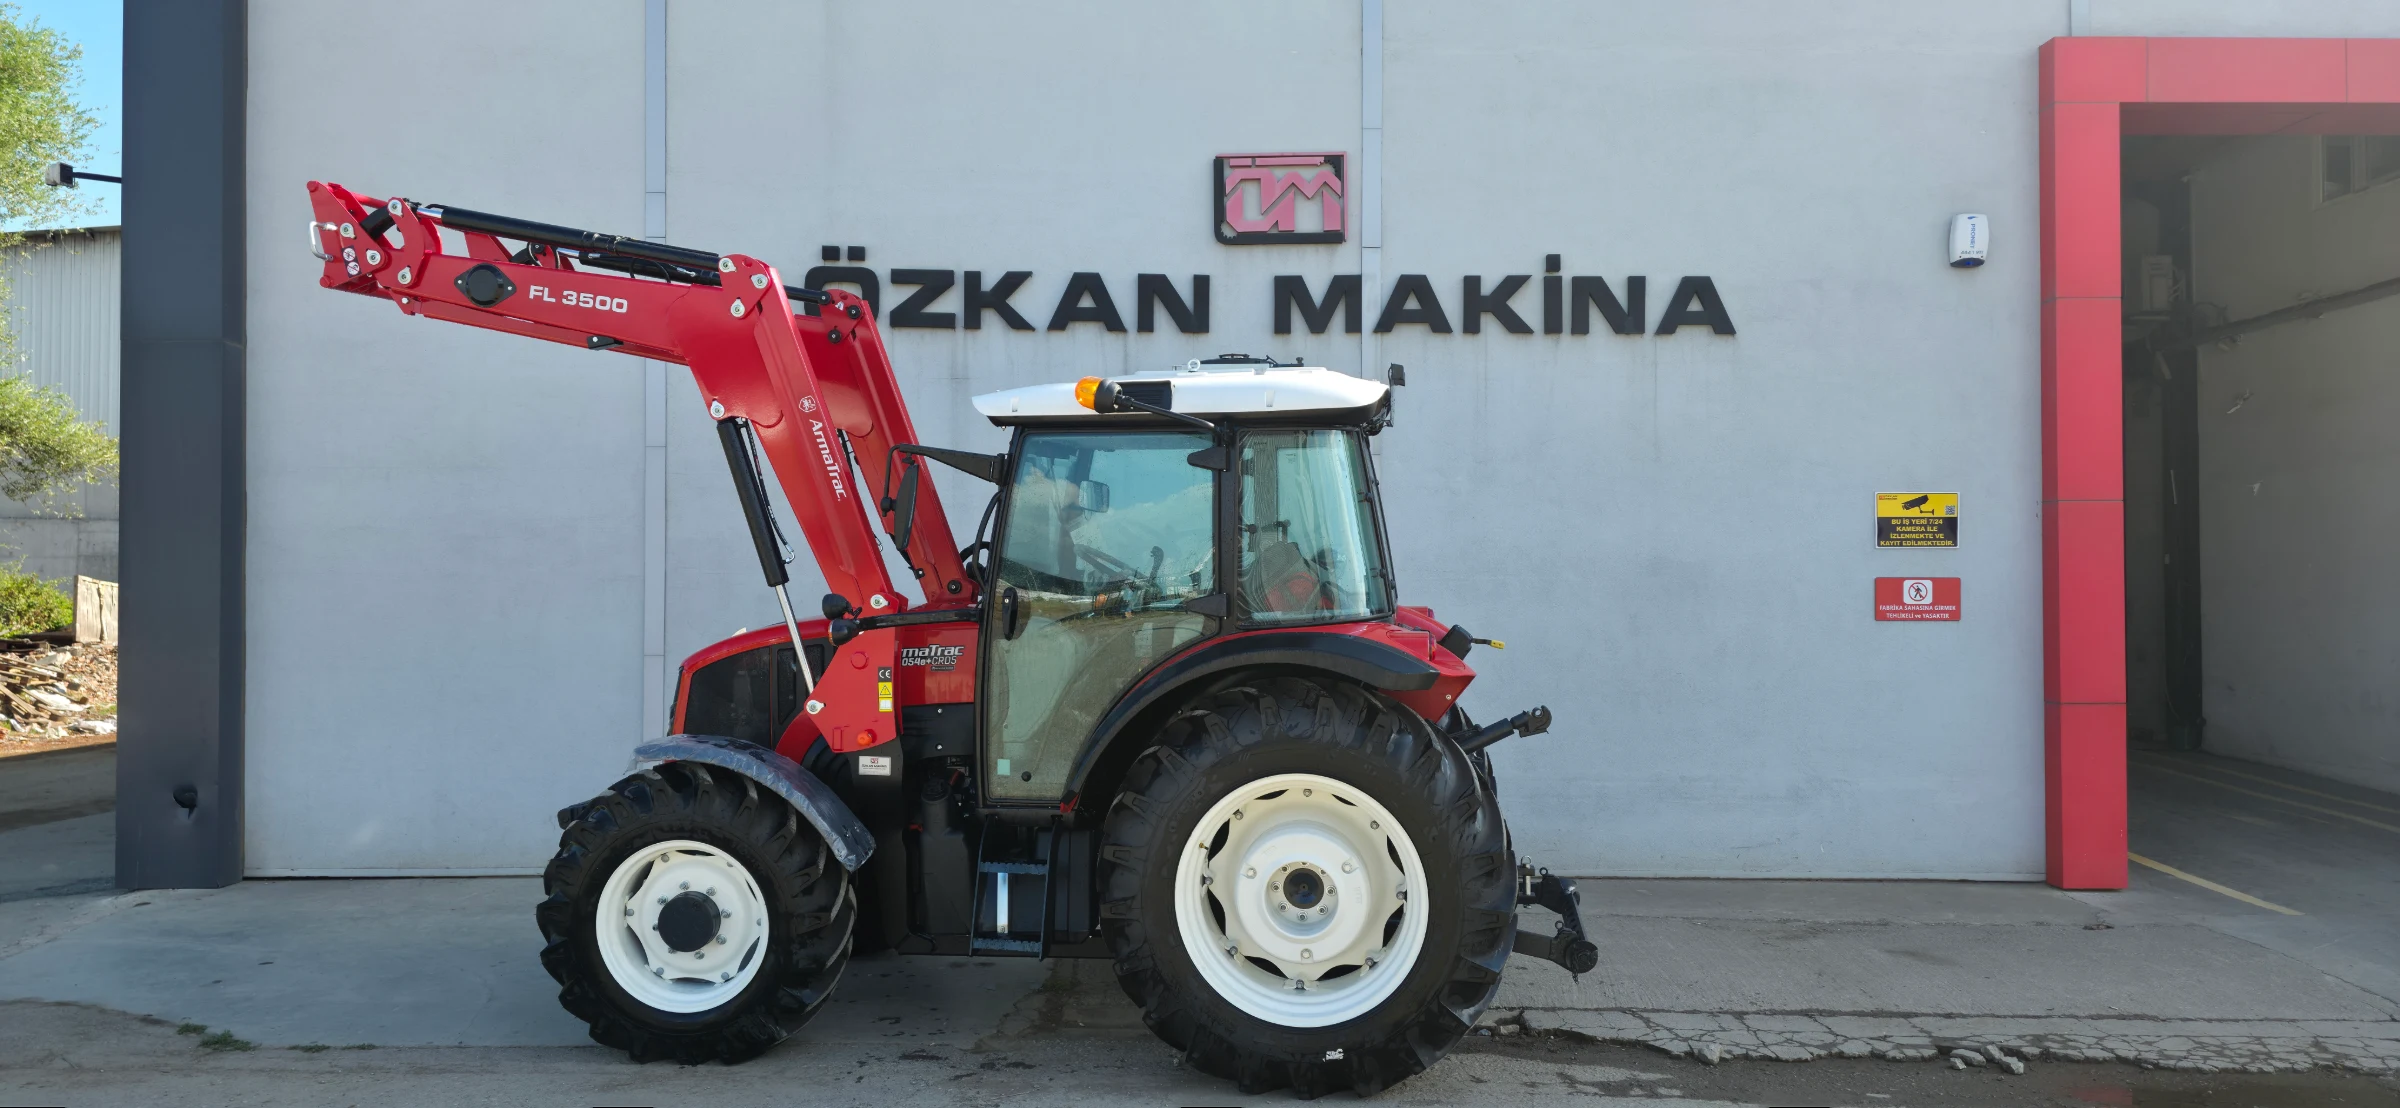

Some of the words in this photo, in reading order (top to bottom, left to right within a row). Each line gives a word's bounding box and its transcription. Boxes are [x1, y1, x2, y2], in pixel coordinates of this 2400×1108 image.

[529, 285, 556, 303] FL
[562, 290, 628, 313] 3500
[803, 245, 1211, 333] ÖZKAN
[1273, 253, 1737, 336] MAKİNA
[809, 419, 847, 499] ArmaTrac
[1902, 518, 1910, 526] İŞ
[901, 644, 965, 658] maTrac
[878, 669, 891, 679] CE
